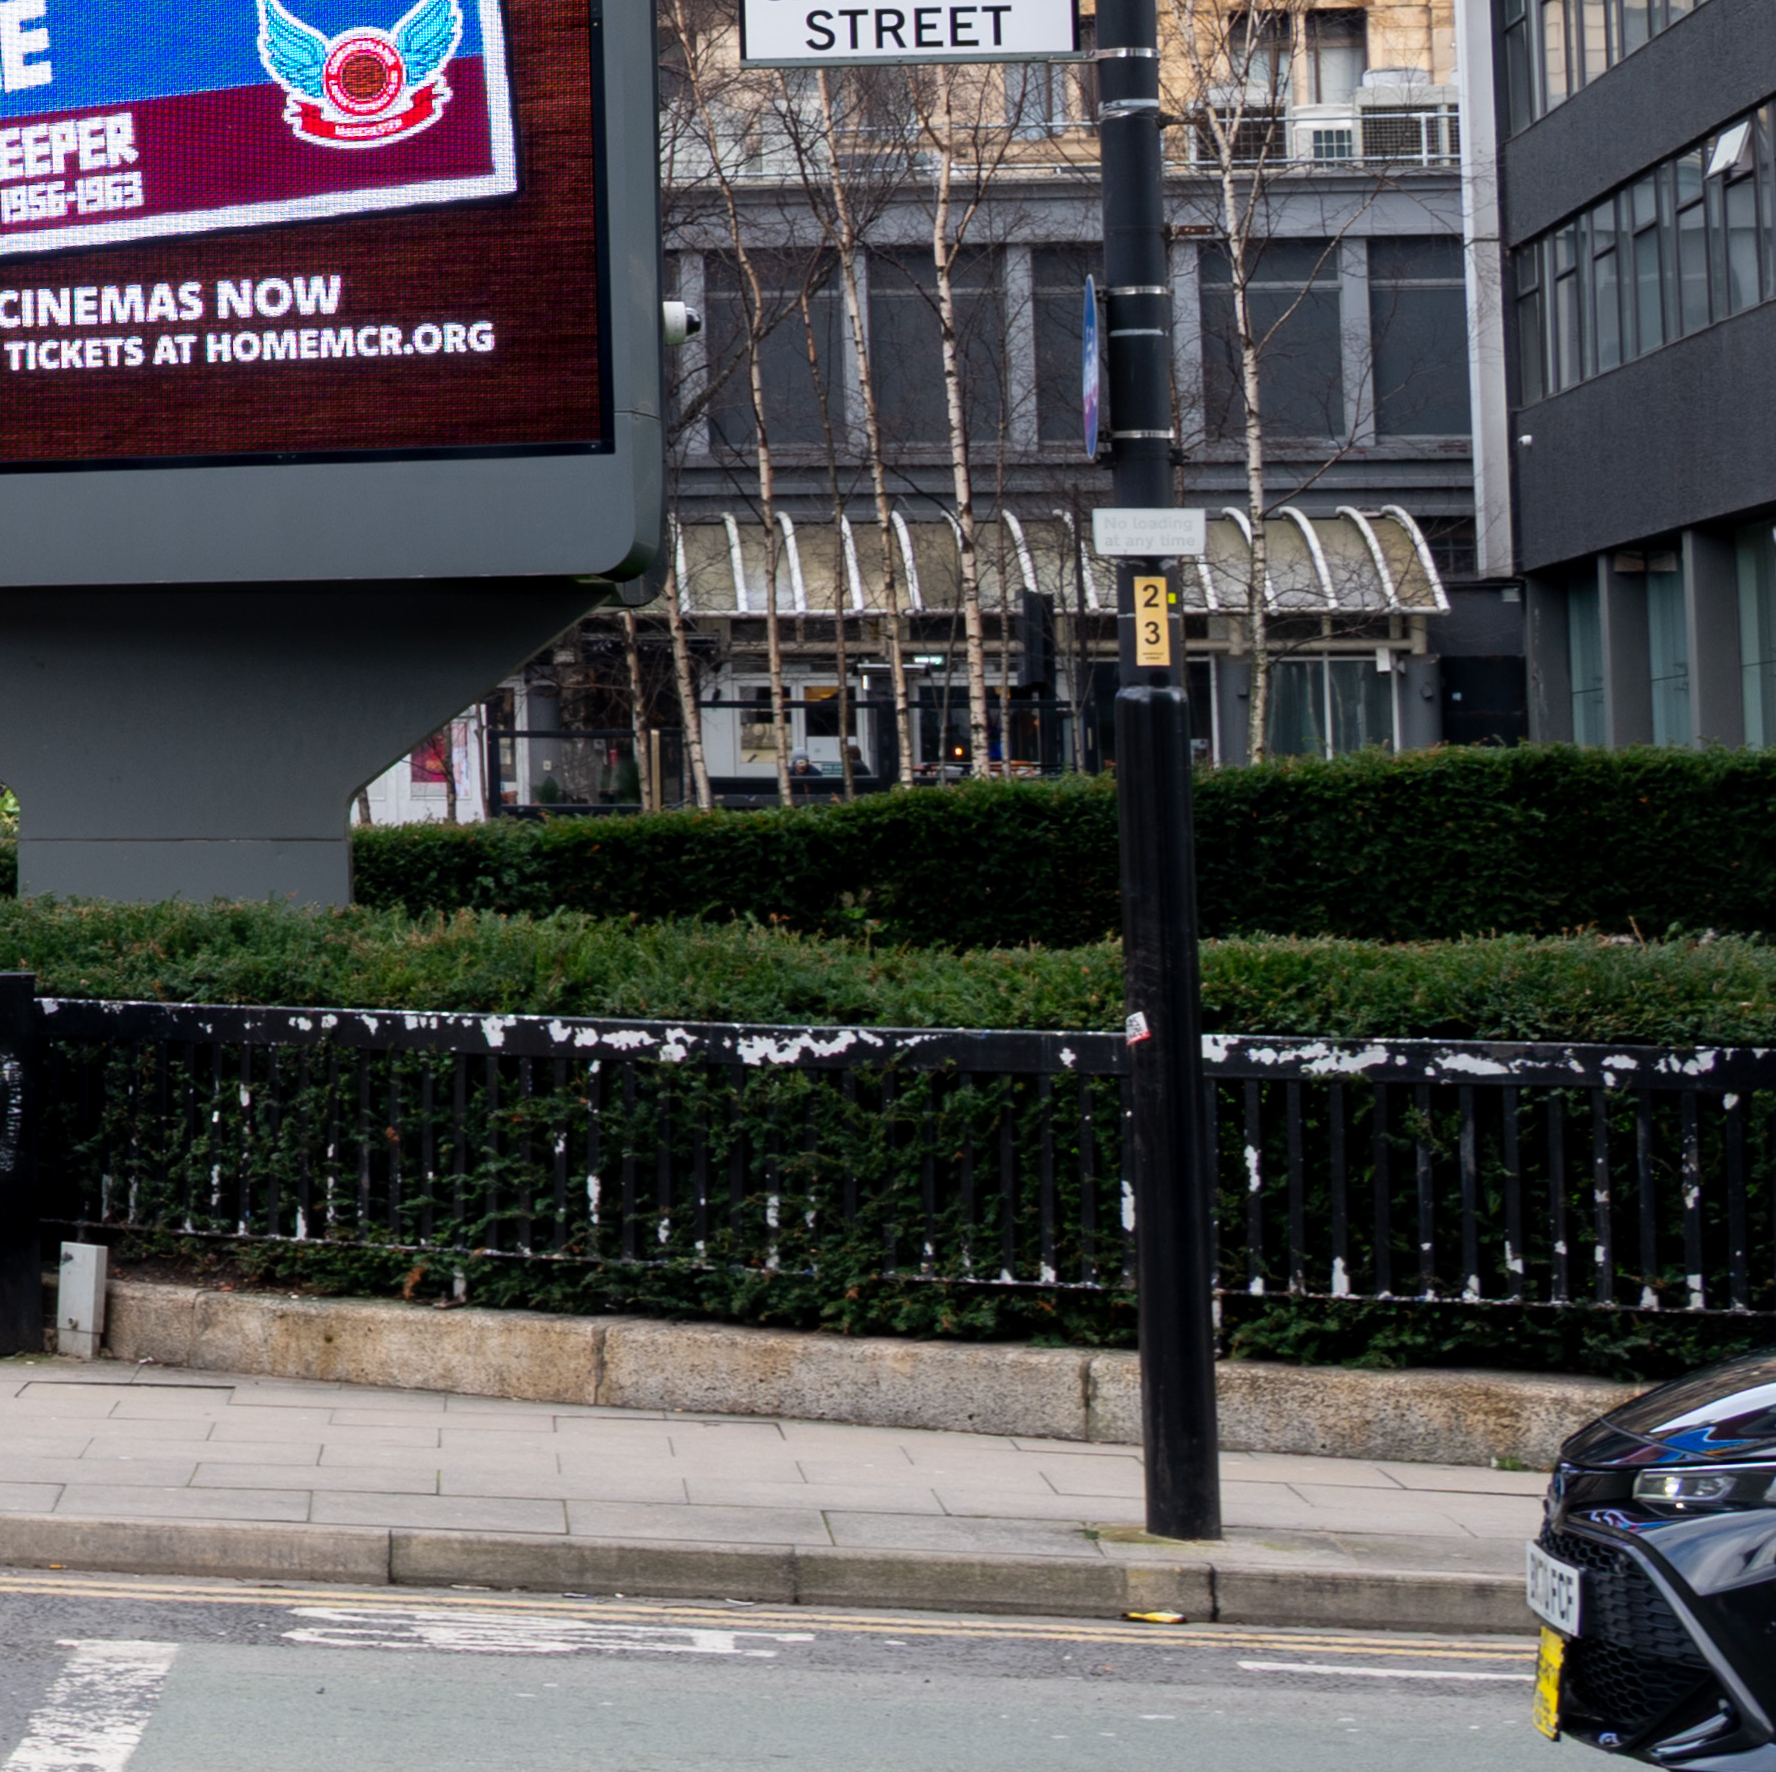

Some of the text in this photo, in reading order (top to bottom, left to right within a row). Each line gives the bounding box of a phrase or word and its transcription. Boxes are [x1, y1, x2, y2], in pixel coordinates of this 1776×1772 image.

[805, 5, 1013, 51] STREET
[0, 171, 145, 225] 1956-1963
[217, 274, 343, 318] NOW
[4, 334, 145, 373] TICKETS
[153, 331, 203, 367] AT
[206, 321, 496, 365] HOMEMCR.ORG
[1104, 517, 1192, 532] No loading
[1105, 534, 1195, 549] at any time
[1142, 584, 1159, 607] 2
[1144, 621, 1160, 645] 3
